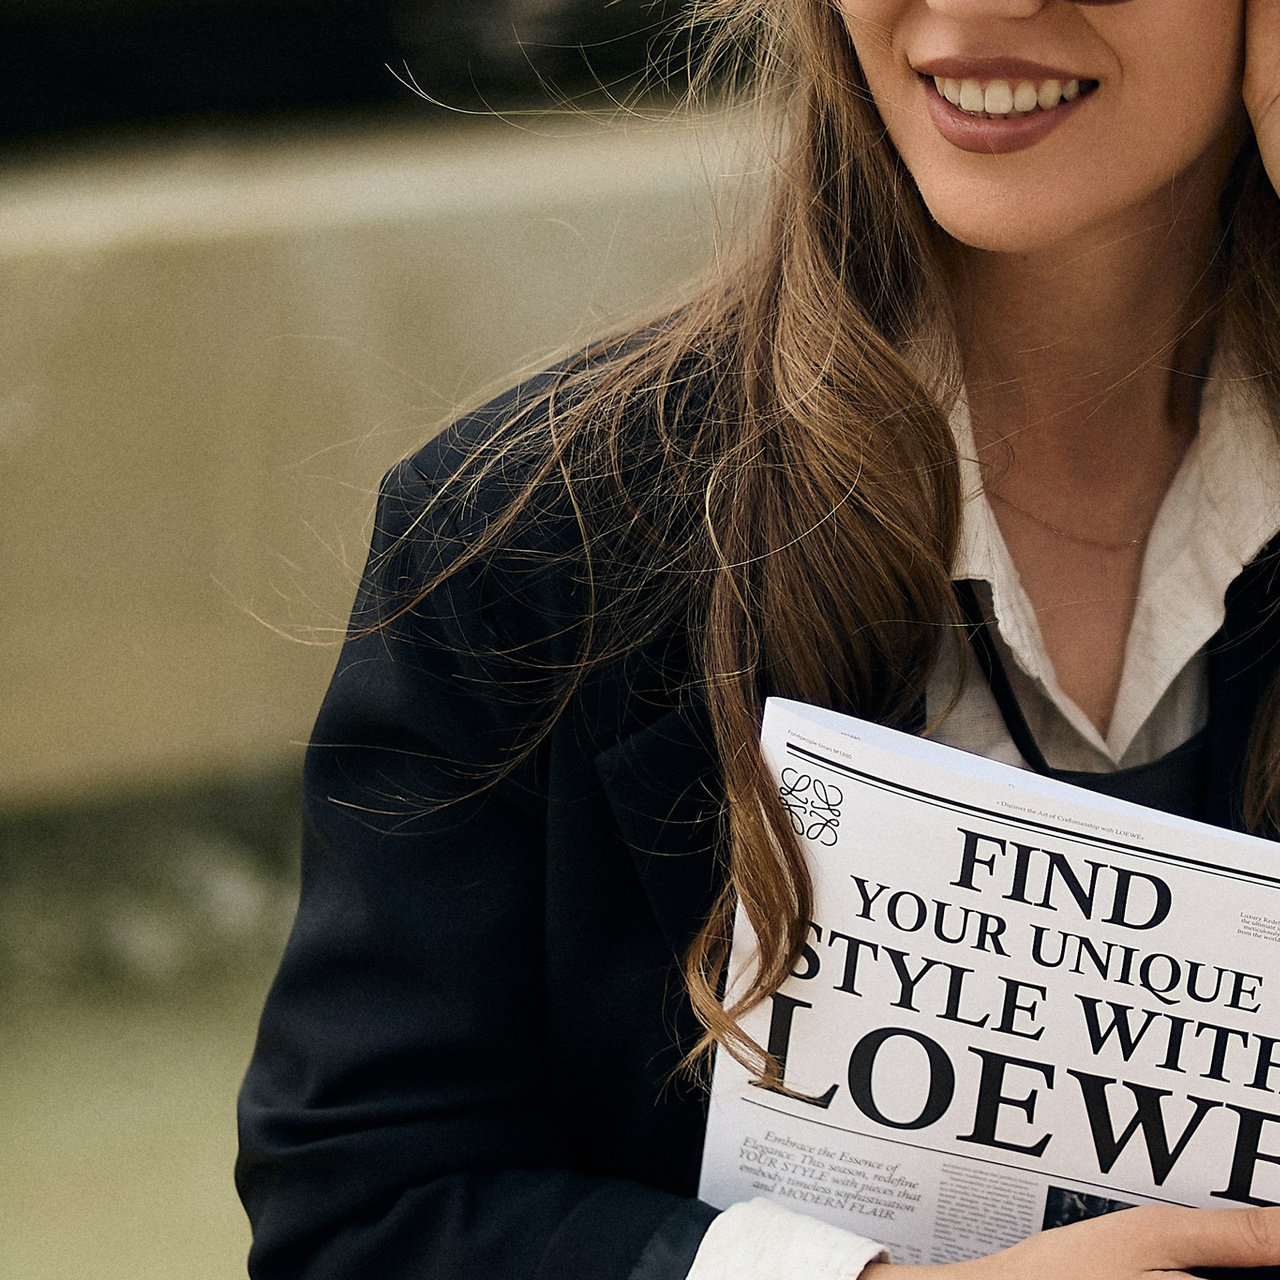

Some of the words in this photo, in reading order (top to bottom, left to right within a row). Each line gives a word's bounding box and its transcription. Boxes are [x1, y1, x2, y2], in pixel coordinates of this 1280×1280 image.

[1001, 800, 1027, 813] Discover
[1027, 806, 1038, 815] the
[1038, 810, 1049, 818] Art
[1057, 814, 1100, 831] Craftsmanship
[1101, 825, 1114, 834] with
[950, 826, 1173, 931] FIND
[1237, 928, 1252, 937] from
[1240, 911, 1262, 922] Luxury
[1243, 924, 1280, 937] meticulously
[1251, 921, 1276, 931] ultimate
[850, 874, 1012, 958] YOUR
[1031, 926, 1265, 1014] UNIQUE
[787, 919, 1048, 1041] STYLE
[764, 1130, 816, 1154] Embrace
[817, 1146, 837, 1159] the
[839, 1151, 884, 1171] Essence
[886, 1163, 901, 1176] of
[800, 1153, 826, 1169] This
[828, 1163, 869, 1181] season,
[873, 1171, 920, 1190] redefine
[738, 1147, 778, 1169] YOUR
[780, 1160, 831, 1182] STYLE
[832, 1175, 859, 1189] with
[860, 1182, 895, 1198] pieces
[897, 1189, 923, 1203] that
[739, 1163, 785, 1183] embody
[786, 1175, 833, 1195] timeless
[834, 1187, 916, 1213] sophistication
[752, 1180, 777, 1194] and
[778, 1186, 847, 1210] MODERN
[849, 1202, 898, 1221] FLAIR
